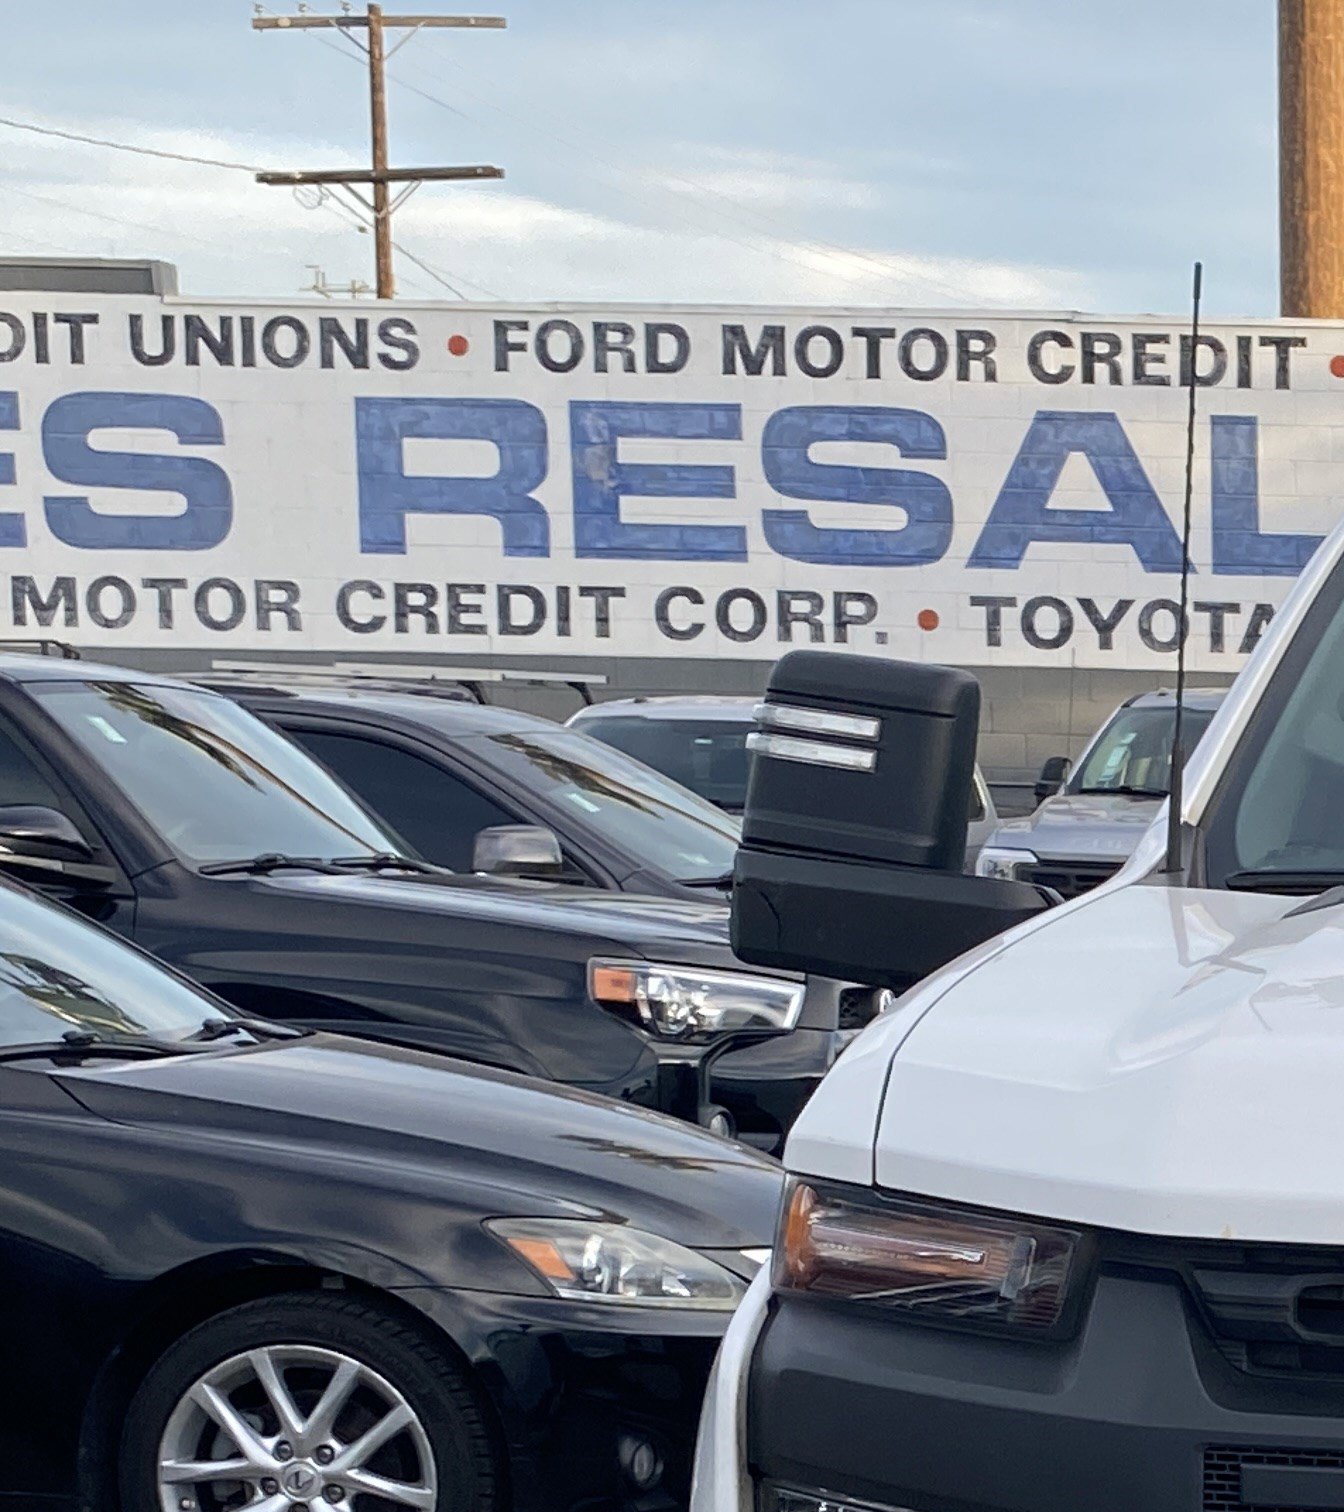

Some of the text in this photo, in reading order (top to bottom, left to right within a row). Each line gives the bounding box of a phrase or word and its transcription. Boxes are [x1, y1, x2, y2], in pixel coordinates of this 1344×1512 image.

[129, 314, 420, 370] UNIONS
[494, 319, 690, 373] FORD
[722, 324, 998, 382] MOTOR
[1028, 330, 1307, 390] CREDIT
[11, 575, 303, 632] MOTOR
[336, 580, 626, 639] CREDIT
[655, 586, 888, 645] CORP.
